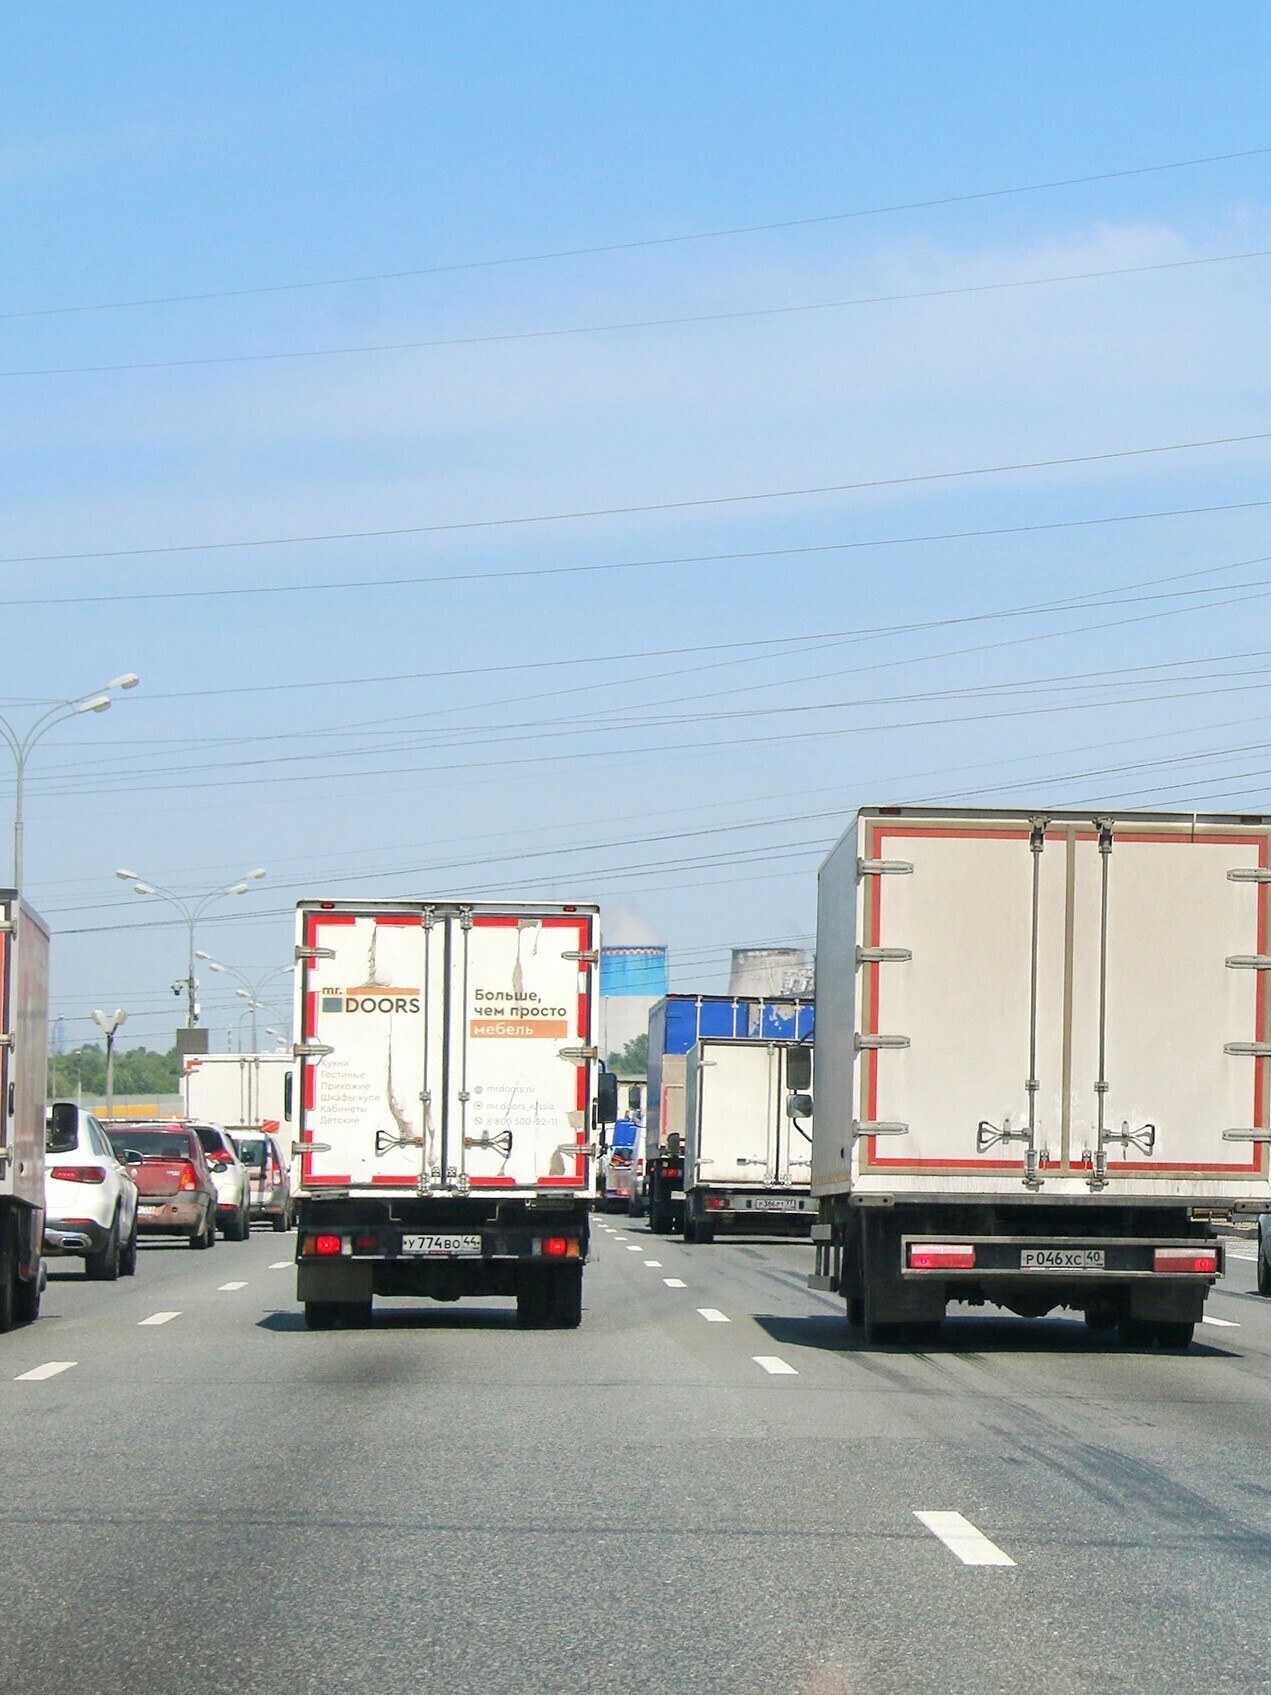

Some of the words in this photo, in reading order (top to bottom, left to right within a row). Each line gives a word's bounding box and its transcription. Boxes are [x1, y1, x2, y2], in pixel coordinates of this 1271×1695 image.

[322, 987, 343, 995] mr.
[475, 988, 541, 1004] Больше,
[345, 998, 420, 1013] DOORS
[474, 1007, 505, 1016] чем
[510, 1006, 567, 1019] просто
[474, 1022, 534, 1036] мебель
[321, 1060, 349, 1069] Кухни
[320, 1070, 366, 1079] Гостиные
[320, 1082, 371, 1091] Прихожие
[320, 1093, 381, 1103] Шкафы-купе
[320, 1104, 368, 1113] Кабинеты
[320, 1115, 360, 1125] Детские
